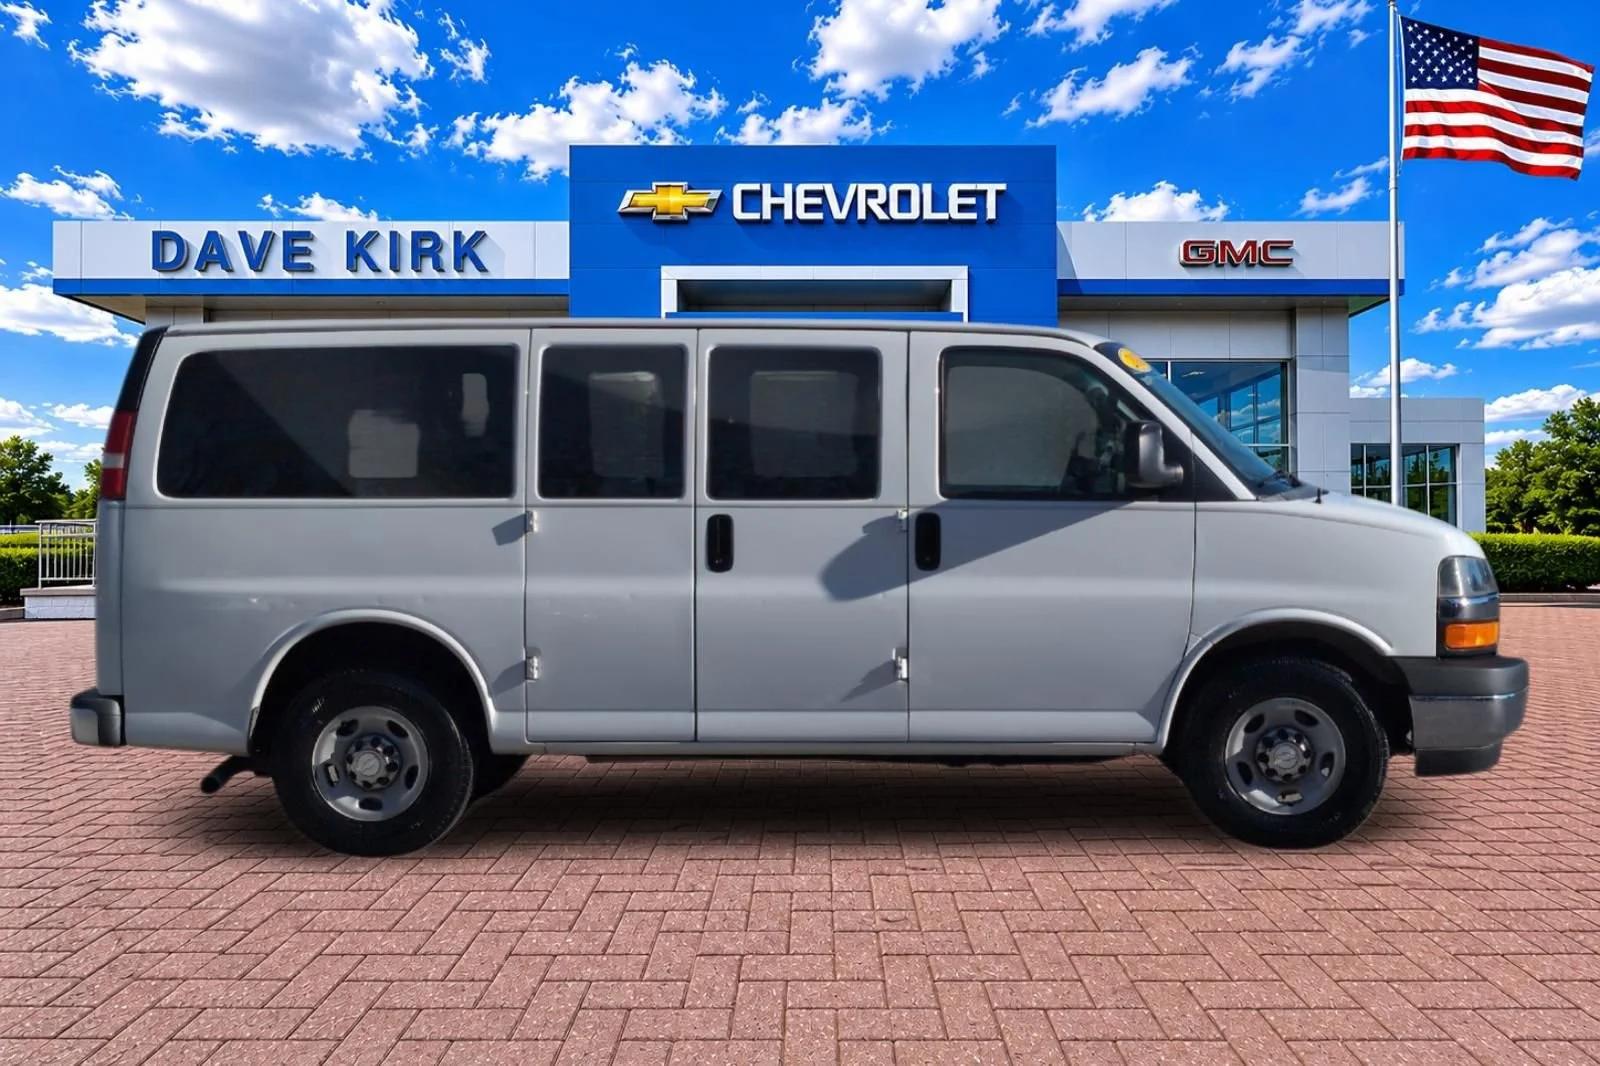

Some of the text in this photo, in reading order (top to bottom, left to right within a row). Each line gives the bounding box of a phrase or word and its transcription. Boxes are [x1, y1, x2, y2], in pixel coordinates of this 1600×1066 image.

[732, 182, 1007, 222] CHEVROLET
[151, 230, 490, 273] DAVE KIRK
[1179, 239, 1295, 267] GMC
